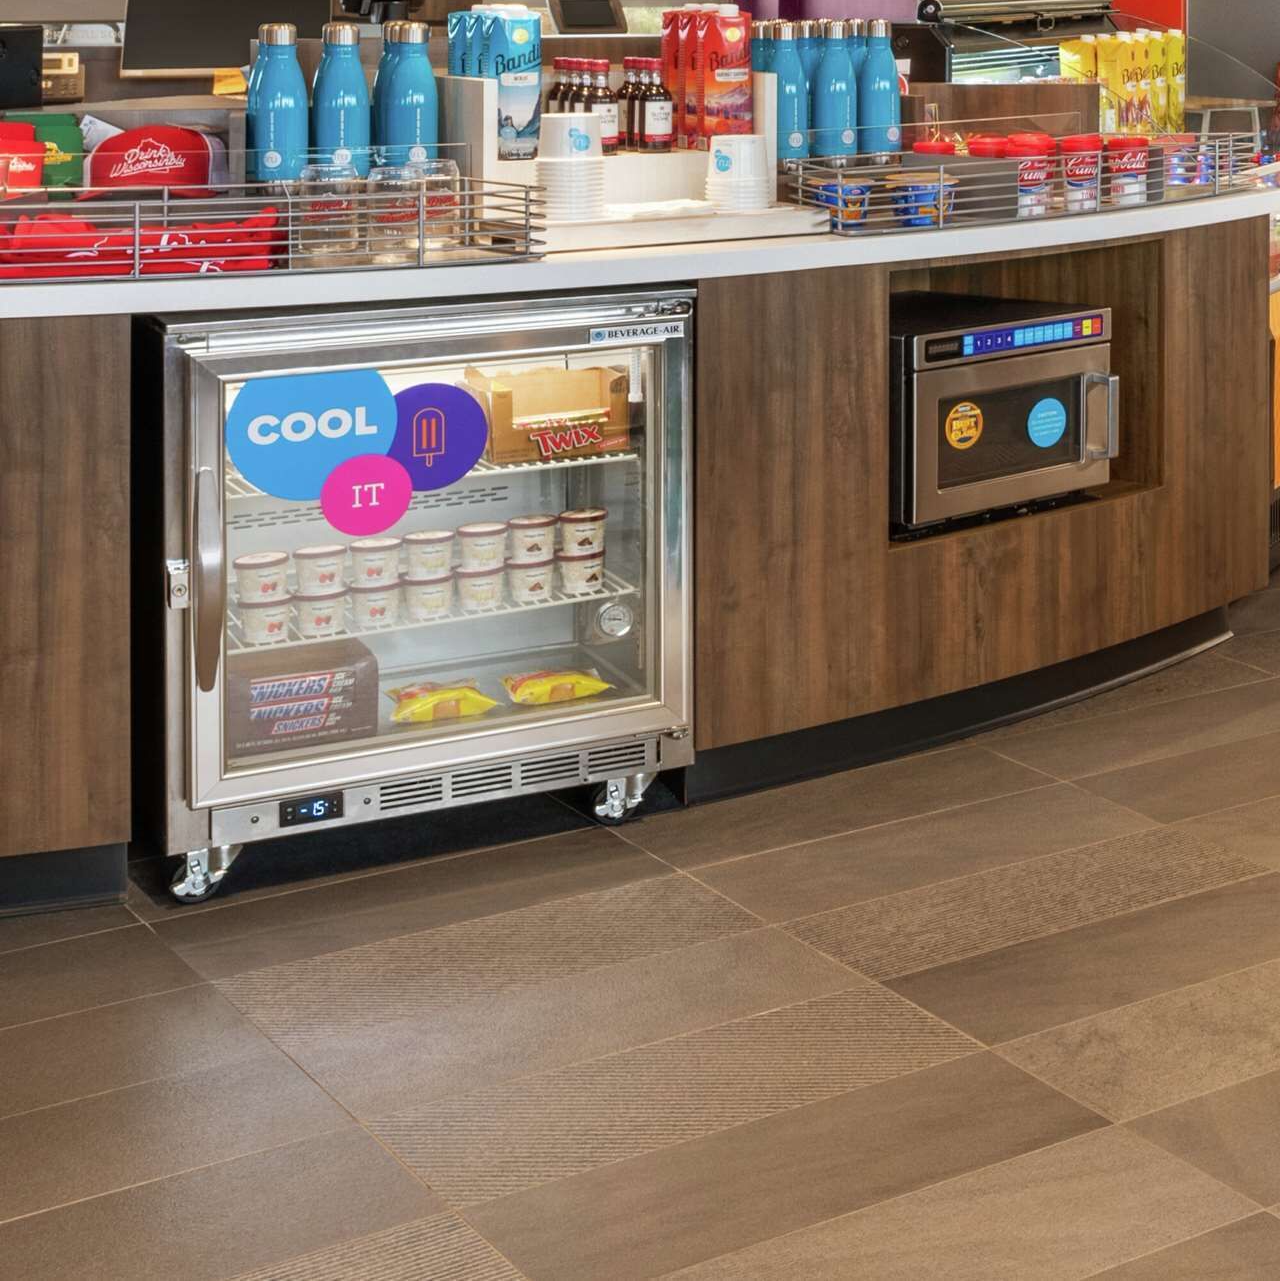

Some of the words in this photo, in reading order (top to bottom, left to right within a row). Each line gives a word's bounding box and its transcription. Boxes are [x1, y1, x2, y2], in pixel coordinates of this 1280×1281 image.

[125, 144, 169, 164] Drink
[608, 325, 680, 338] BEVERAGE-AIR
[247, 406, 378, 445] COOL
[351, 483, 385, 508] IT
[275, 718, 323, 733] SNICKERS
